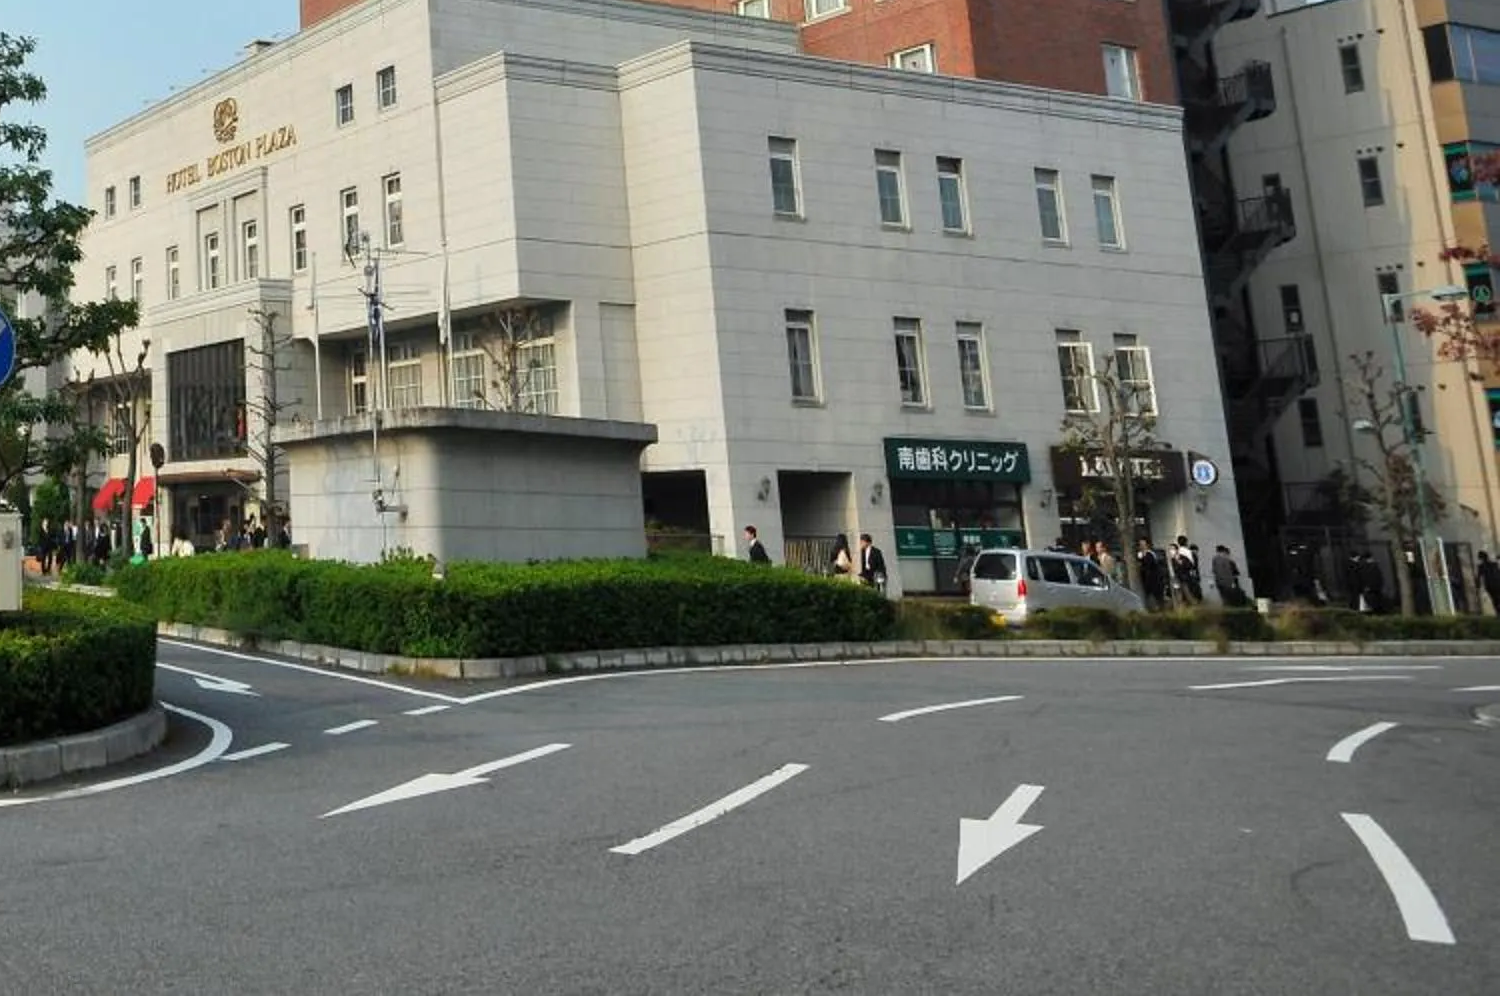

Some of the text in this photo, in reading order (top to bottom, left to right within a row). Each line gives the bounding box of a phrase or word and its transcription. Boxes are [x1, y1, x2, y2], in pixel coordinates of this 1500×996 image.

[166, 124, 297, 193] HOTEL BOSTON PLAZA
